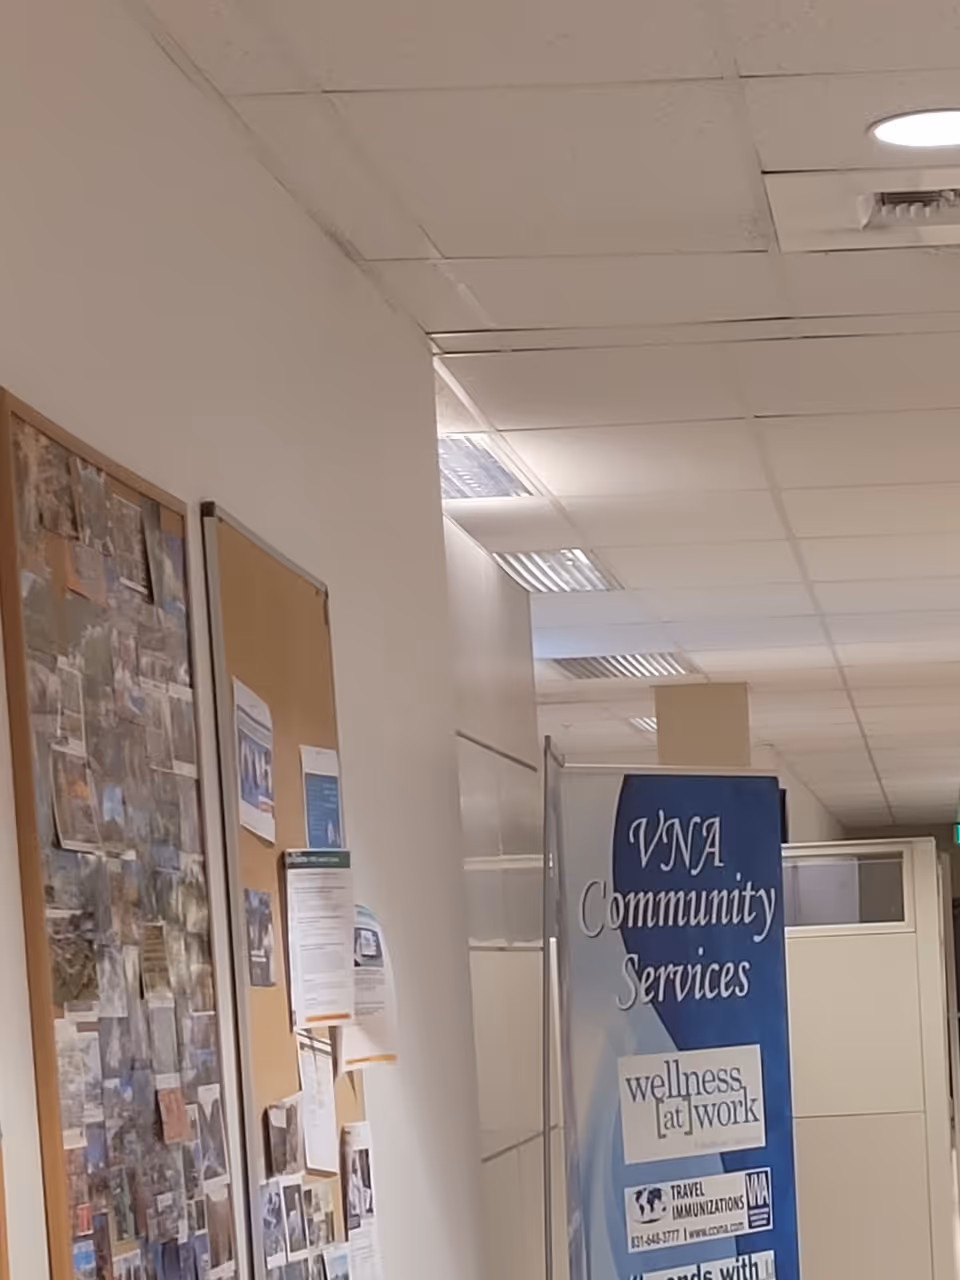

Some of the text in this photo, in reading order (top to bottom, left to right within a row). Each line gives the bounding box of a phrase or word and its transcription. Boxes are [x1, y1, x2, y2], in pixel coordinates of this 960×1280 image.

[629, 809, 724, 875] VNA
[579, 873, 775, 942] Community
[616, 947, 750, 1010] Services
[625, 1059, 742, 1103] wellness
[693, 1086, 760, 1129] work
[670, 1181, 705, 1201] TRAVEL
[672, 1195, 745, 1220] IMMUNIZATIONS
